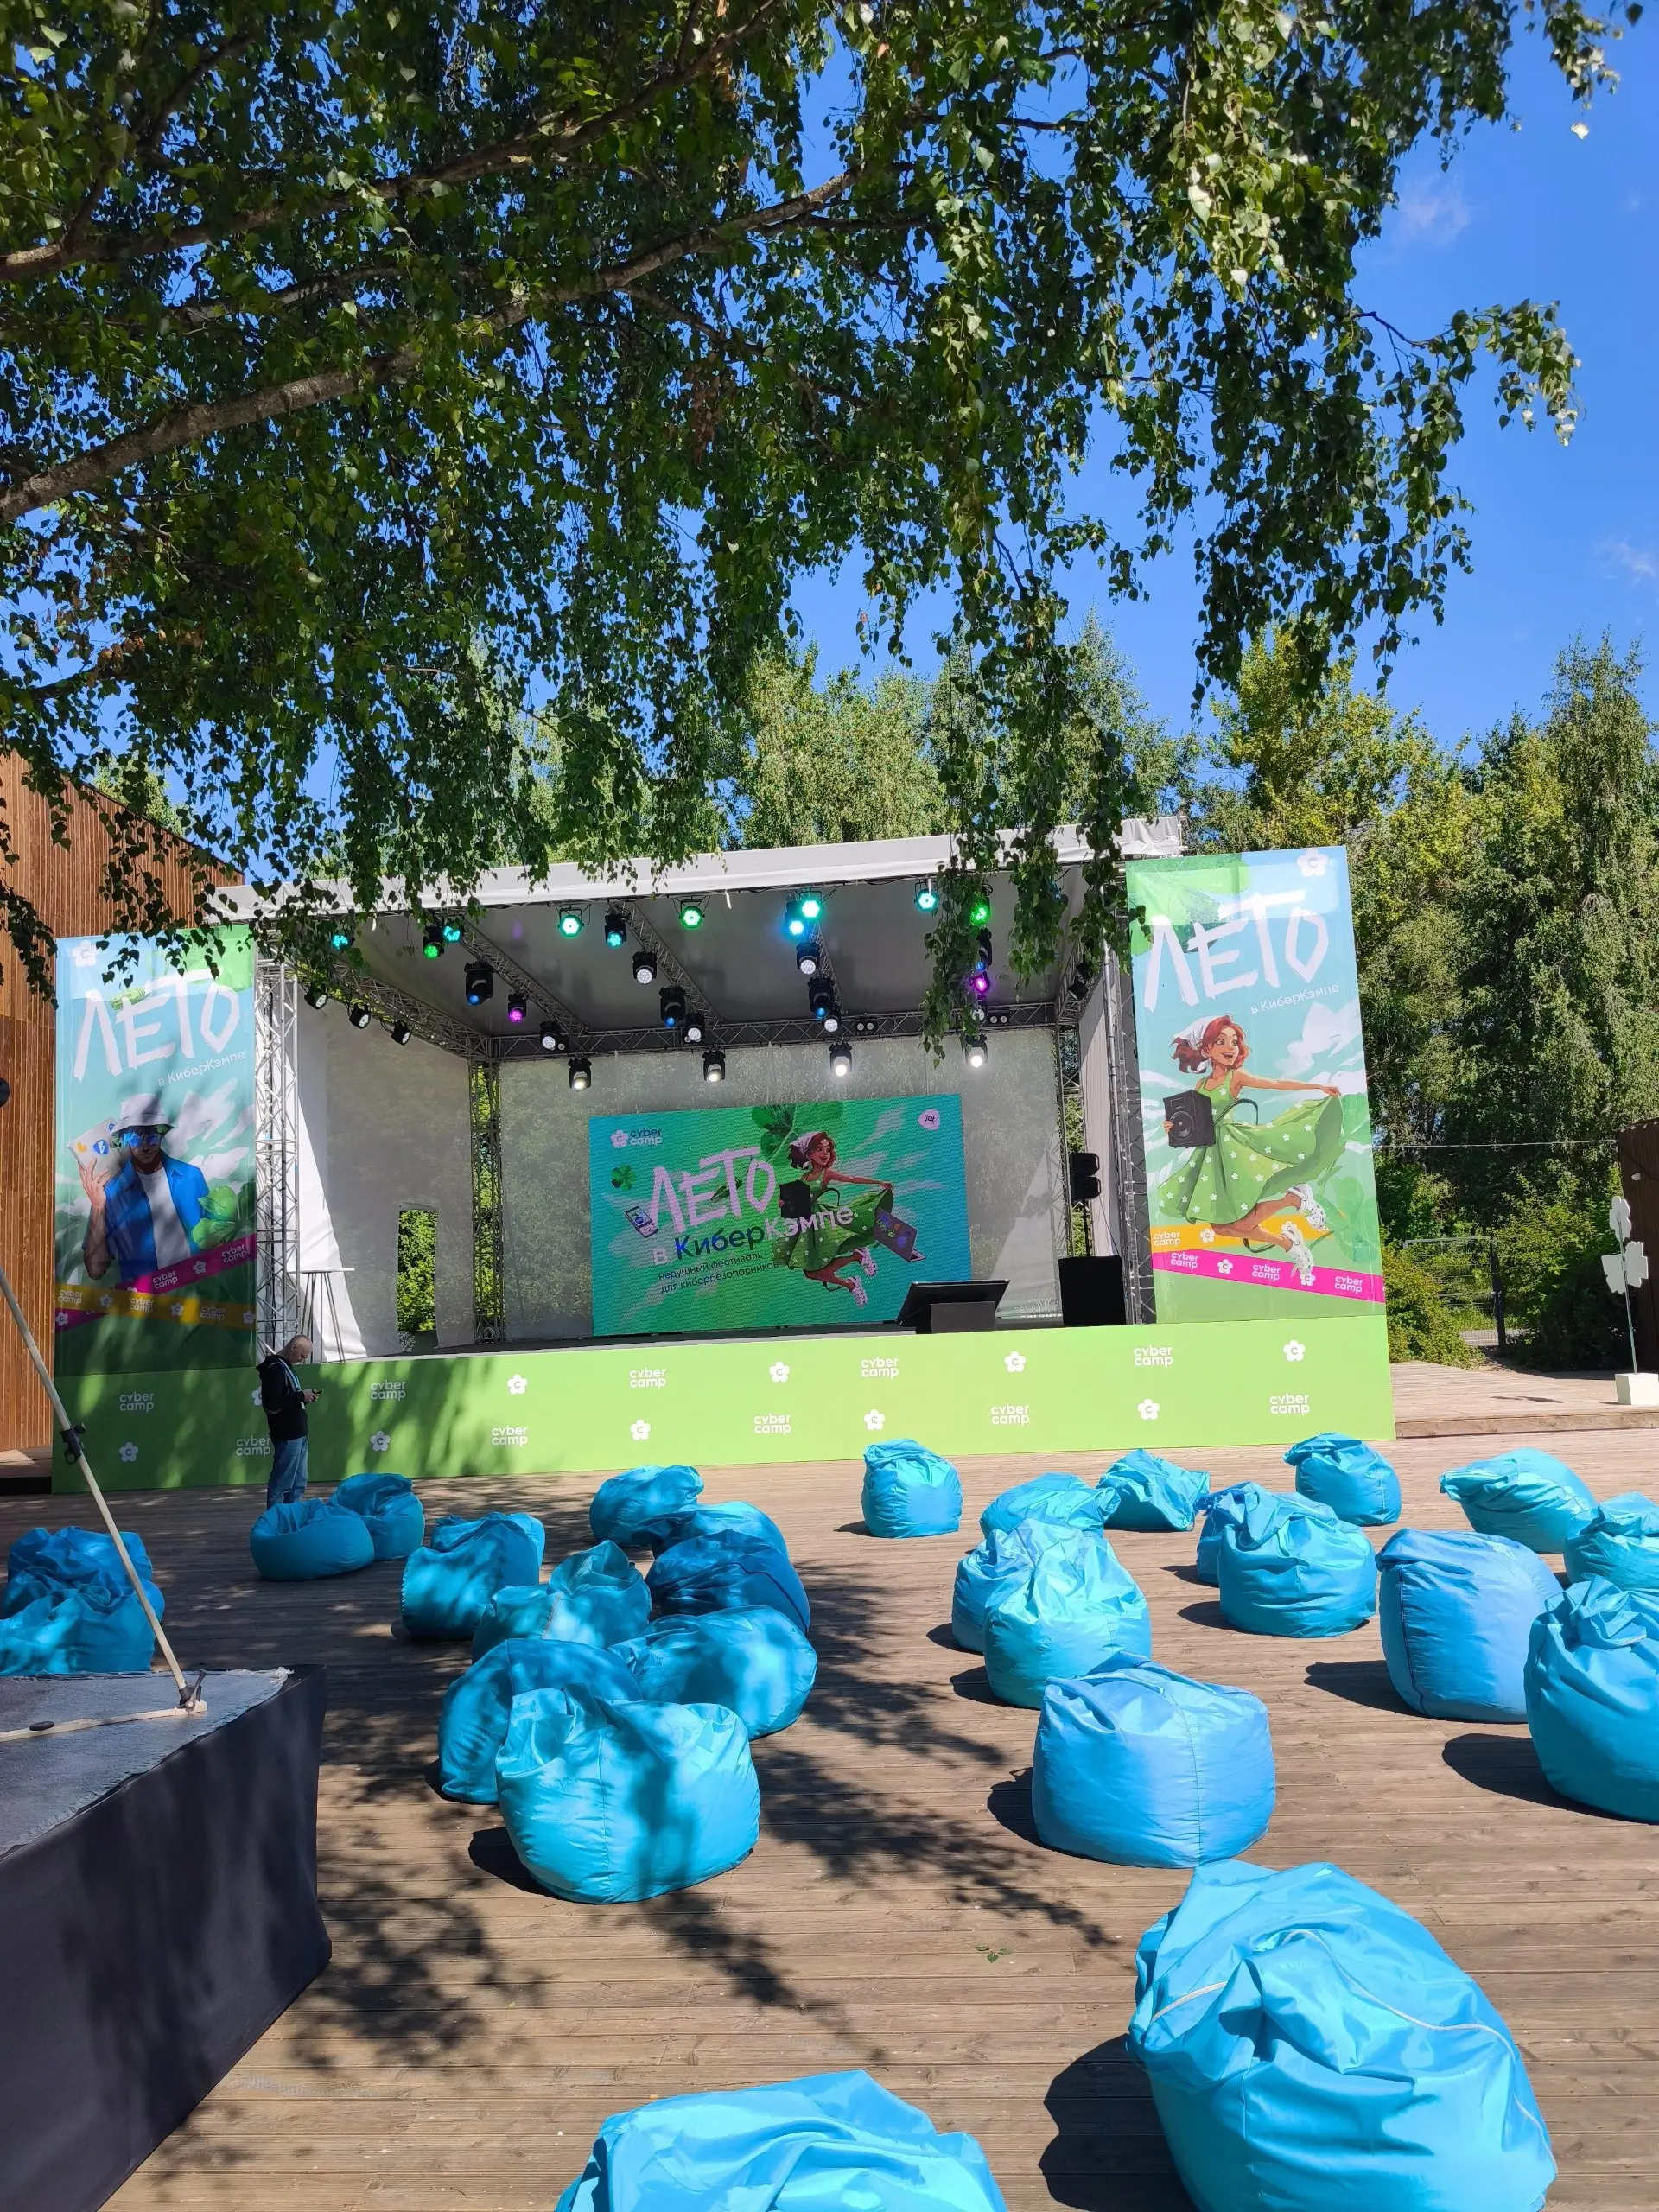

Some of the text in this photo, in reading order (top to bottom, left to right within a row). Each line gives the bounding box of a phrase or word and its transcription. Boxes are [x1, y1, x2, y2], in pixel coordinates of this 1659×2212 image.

[1143, 889, 1330, 1013] ЛЕТО
[1250, 982, 1339, 1014] в КиберКэмпе
[73, 967, 240, 1082] ЛЕТО
[158, 1051, 246, 1086] в КиберКэмпе
[630, 1128, 662, 1138] cyber
[630, 1136, 662, 1147] camp
[650, 1147, 776, 1234] ЛЕТО
[1154, 1230, 1180, 1240] cyber
[1154, 1237, 1180, 1246] camp
[221, 1244, 245, 1257] cyber
[223, 1250, 247, 1262] camp
[653, 1248, 668, 1265] в
[1171, 1252, 1199, 1262] cyber
[658, 1252, 763, 1281] недушный фестиваль
[1171, 1259, 1198, 1269] camp
[1253, 1263, 1281, 1274] cyber
[153, 1271, 175, 1283] cyber
[661, 1261, 779, 1294] для кибербезопасников
[1252, 1270, 1280, 1282] camp
[1335, 1276, 1363, 1286] cyber
[155, 1276, 178, 1289] camp
[1334, 1282, 1362, 1294] camp
[59, 1289, 83, 1298] cyber
[58, 1296, 82, 1305] camp
[130, 1304, 153, 1313] camp
[200, 1312, 225, 1321] camp
[1134, 1344, 1173, 1357] cyber
[861, 1356, 899, 1368] cyber
[1134, 1355, 1173, 1368] camp
[629, 1367, 667, 1379] cyber
[861, 1366, 899, 1379] camp
[370, 1379, 406, 1392] cyber
[629, 1376, 667, 1389] camp
[119, 1391, 155, 1402] cyber
[370, 1390, 406, 1402] camp
[1269, 1393, 1310, 1405] cyber
[119, 1401, 155, 1412] camp
[991, 1403, 1029, 1415] cyber
[1270, 1403, 1310, 1415] camp
[753, 1413, 791, 1425] cyber
[991, 1413, 1030, 1427] camp
[491, 1424, 528, 1437] cyber
[753, 1423, 791, 1435] camp
[236, 1436, 271, 1447] cyber
[491, 1435, 528, 1447] camp
[236, 1445, 271, 1457] camp
